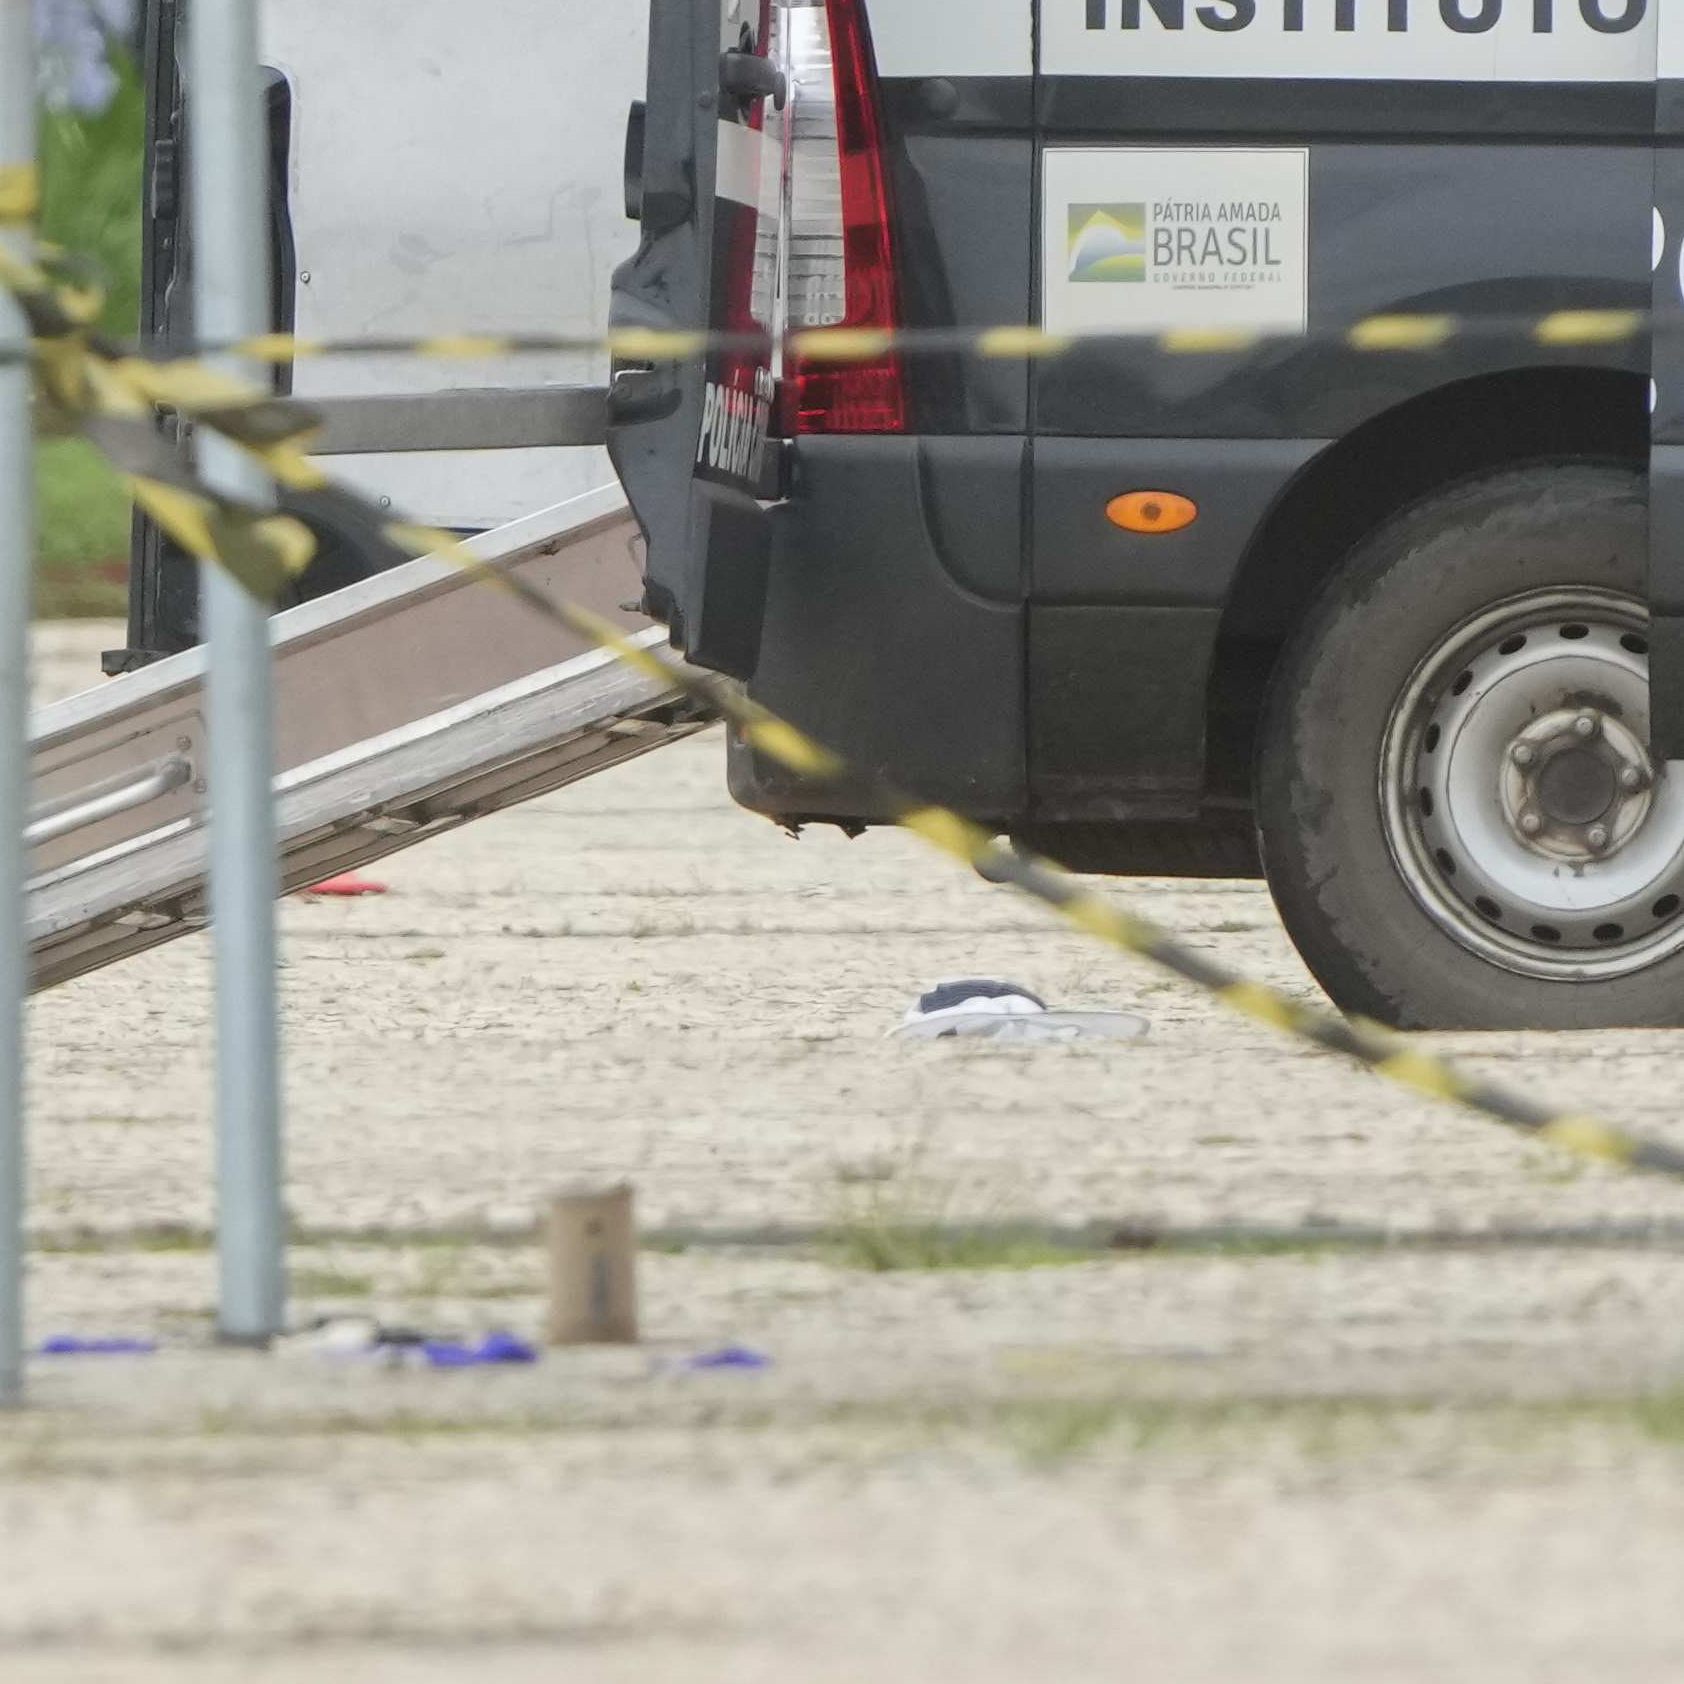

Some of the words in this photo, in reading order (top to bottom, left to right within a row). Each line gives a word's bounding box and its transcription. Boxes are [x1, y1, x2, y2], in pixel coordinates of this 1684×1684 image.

[1153, 197, 1212, 222] PÁTRIA
[1217, 202, 1282, 222] AMADA
[1153, 226, 1282, 267] BRASIL
[1153, 272, 1216, 283] GOVERNO
[1224, 272, 1283, 283] FEDERAL
